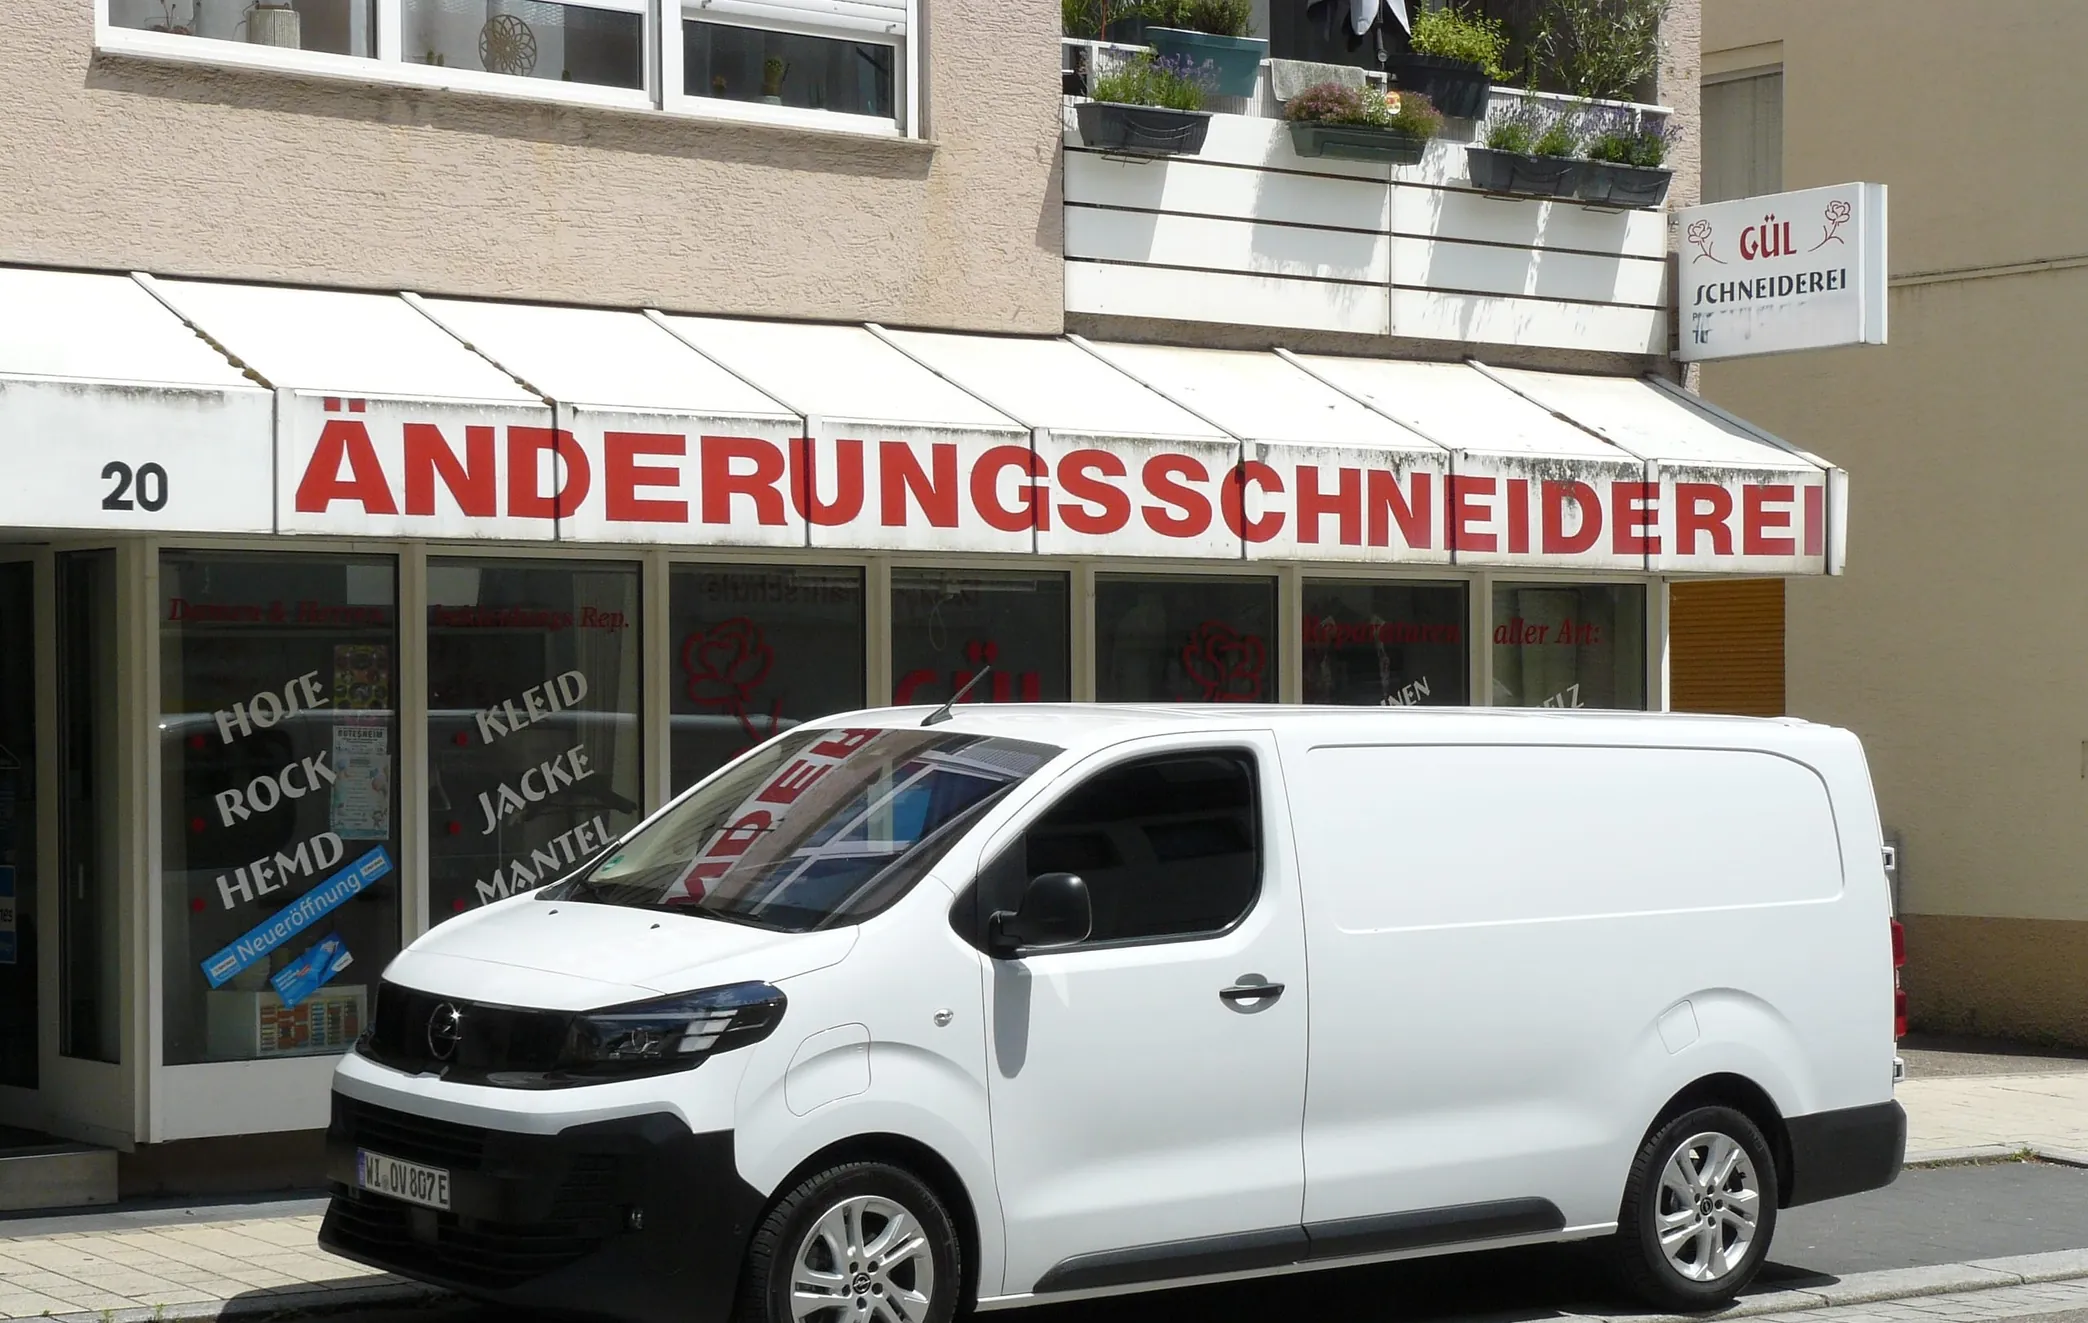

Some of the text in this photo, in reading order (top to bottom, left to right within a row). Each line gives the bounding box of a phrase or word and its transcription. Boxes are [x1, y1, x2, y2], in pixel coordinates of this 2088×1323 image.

[1740, 213, 1797, 261] GÜL
[1693, 268, 1846, 306] SCHNEIDEREI
[101, 461, 168, 512] 20
[295, 398, 1822, 557] ÄNDERUNGSSCHNEIDEREI
[580, 606, 629, 632] Rep.
[1493, 617, 1549, 645] aller
[214, 670, 330, 745] HOSE
[475, 670, 589, 745] KLEID
[215, 750, 337, 828] ROCK
[478, 744, 595, 835] JACKE
[216, 832, 344, 910] HEMD
[475, 815, 618, 906] MANTEL
[236, 871, 361, 962] Neueröffnung
